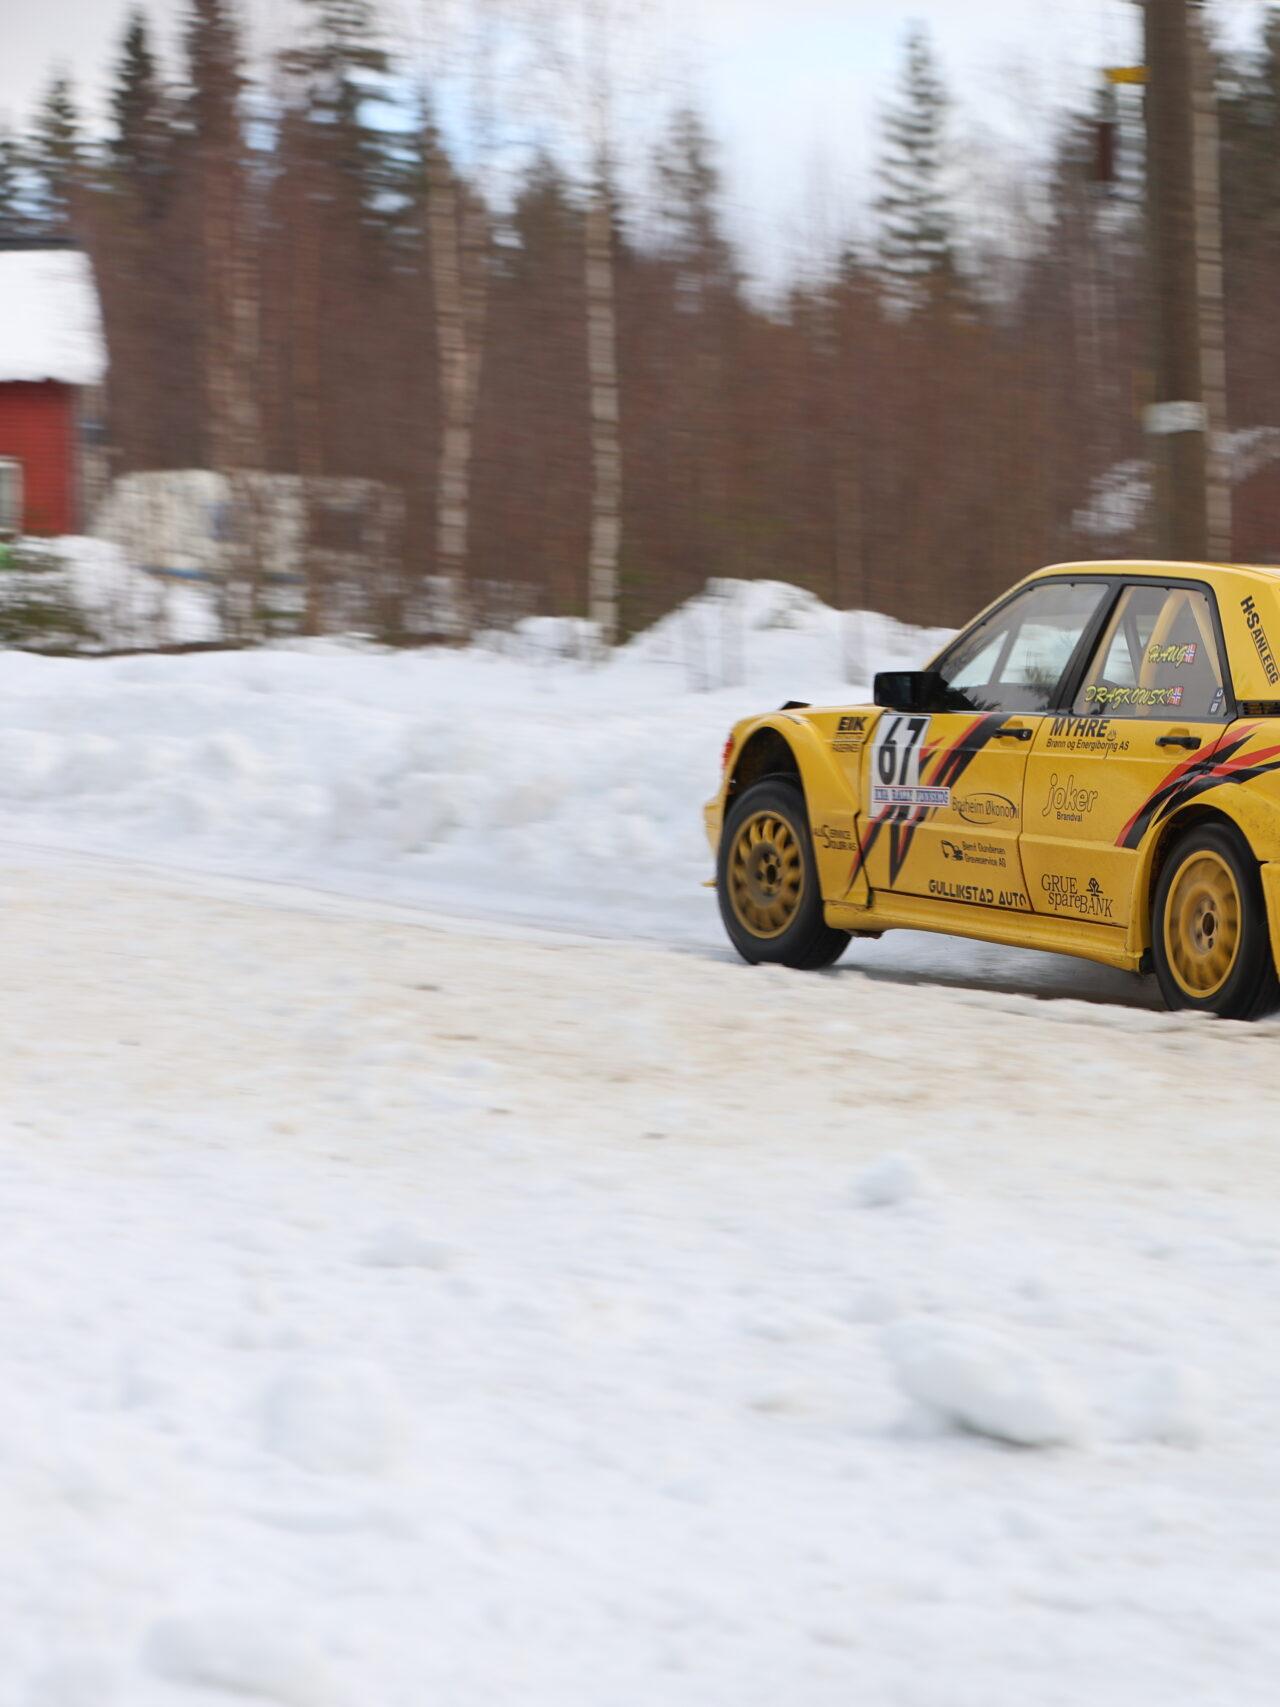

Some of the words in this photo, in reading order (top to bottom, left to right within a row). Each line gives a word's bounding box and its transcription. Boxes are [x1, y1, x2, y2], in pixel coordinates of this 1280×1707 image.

[1149, 644, 1186, 667] HAUG
[837, 716, 867, 731] EIK
[1049, 717, 1109, 737] MYHRE
[878, 717, 928, 785] 67
[1046, 738, 1066, 748] Brønn
[1067, 740, 1076, 750] og
[1077, 739, 1118, 752] Energiboring
[1119, 741, 1129, 751] AS
[1042, 773, 1098, 817] joker
[985, 801, 1019, 819] Økonomi
[1056, 811, 1083, 822] Brandval
[928, 879, 994, 904] GULLIKSTAD
[998, 890, 1027, 907] AUTO
[1041, 873, 1078, 895] GRUE
